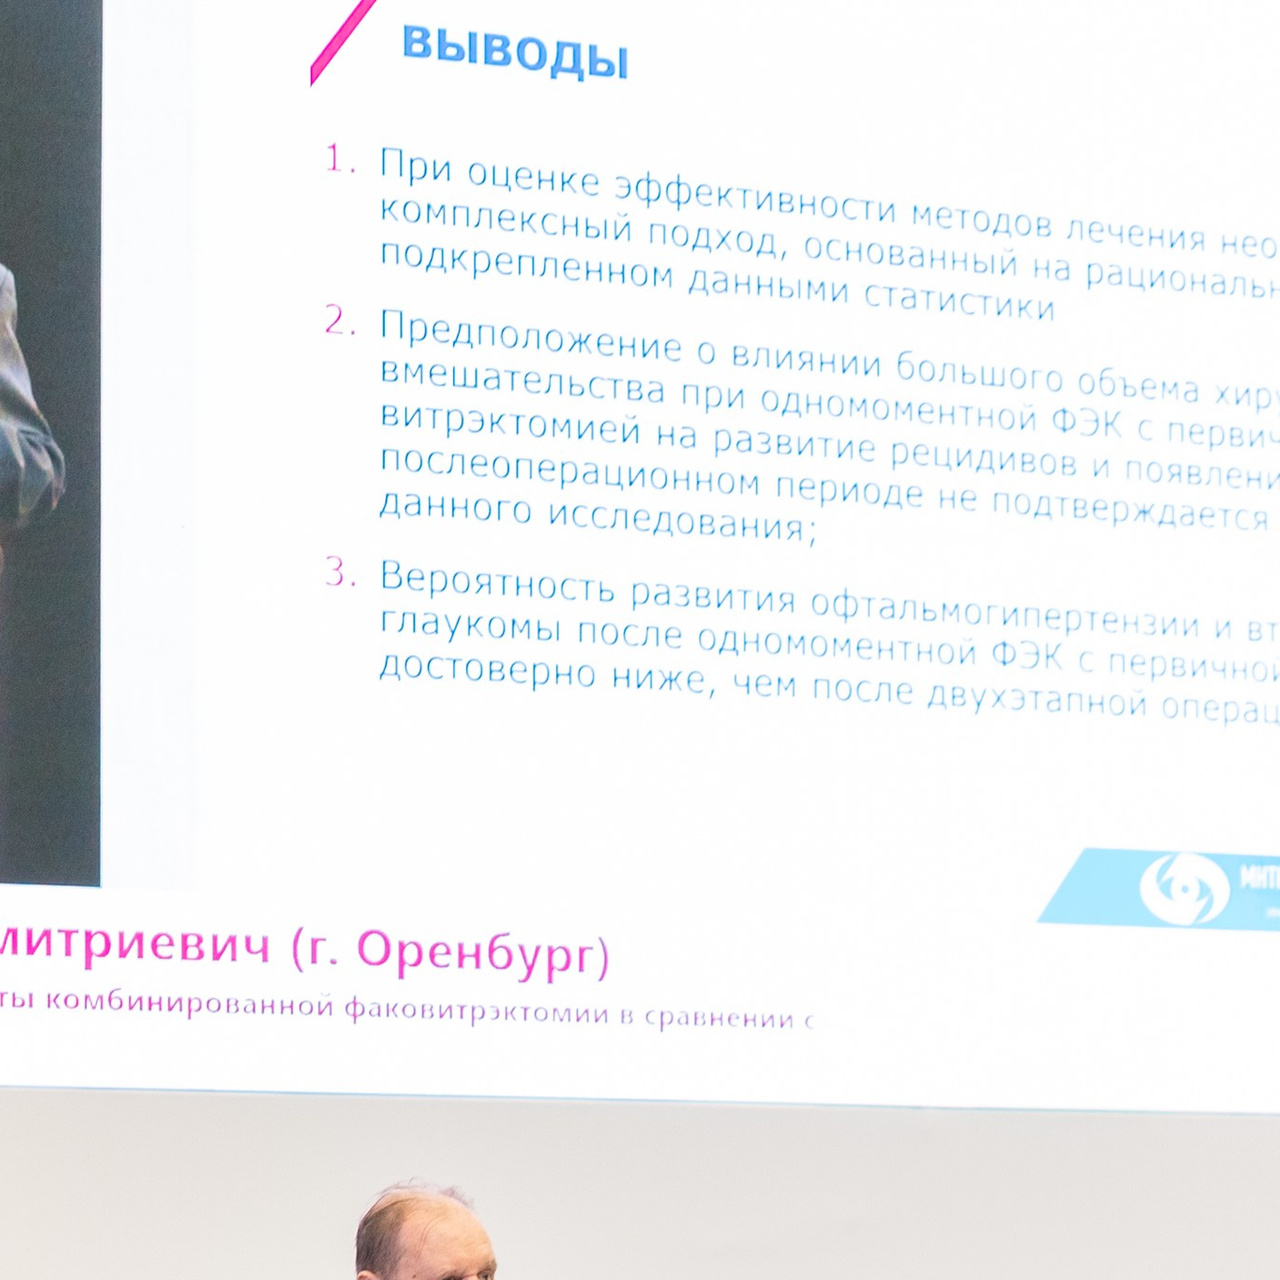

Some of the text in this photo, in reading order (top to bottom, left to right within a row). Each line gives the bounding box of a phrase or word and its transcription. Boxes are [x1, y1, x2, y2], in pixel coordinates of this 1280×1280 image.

[327, 142, 356, 174] 1.
[381, 146, 452, 189] При
[467, 161, 600, 198] оценке
[614, 169, 896, 224] эффективности
[912, 203, 1053, 239] методов
[1066, 219, 1205, 252] лечения
[380, 197, 632, 243] комплексный
[649, 222, 787, 262] подход,
[804, 236, 1017, 277] основанный
[1033, 258, 1071, 282] на
[380, 241, 1055, 322] подкрепленном данными статистики
[325, 303, 356, 336] 2.
[381, 307, 682, 363] Предположение
[697, 341, 716, 366] о
[732, 344, 881, 378] влиянии
[896, 349, 1063, 393] большого
[1077, 366, 1199, 404] объема
[380, 359, 665, 404] вмешательства
[682, 382, 745, 415] при
[760, 389, 1037, 431] одномоментной
[1051, 406, 1122, 438] ФЭК
[1137, 419, 1153, 442] с
[381, 403, 640, 445] витрэктомией
[656, 424, 697, 450] на
[714, 428, 876, 463] развитие
[891, 441, 1077, 477] рецидивов
[1092, 458, 1110, 478] и
[378, 491, 816, 549] данного исследования;
[381, 447, 760, 497] послеоперационном
[776, 475, 924, 511] периоде
[939, 488, 978, 512] не
[993, 491, 1268, 531] подтверждается
[325, 555, 356, 587] 3.
[381, 558, 616, 604] Вероятность
[631, 581, 795, 614] развития
[810, 586, 1199, 638] офтальмогипертензии
[1215, 619, 1231, 639] и
[381, 609, 561, 645] глаукомы
[578, 621, 683, 650] после
[697, 628, 976, 666] одномоментной
[991, 639, 1062, 670] ФЭК
[1078, 651, 1093, 673] с
[378, 653, 596, 693] достоверно
[612, 666, 716, 700] ниже,
[733, 673, 796, 699] чем
[813, 677, 914, 706] после
[926, 684, 1147, 717] двухэтапной
[292, 926, 338, 974] (г.
[357, 928, 609, 985] Оренбург)
[46, 987, 333, 1021] комбинированной
[344, 994, 608, 1028] факовитрэктомии
[620, 1008, 634, 1025] в
[645, 1009, 793, 1033] сравнении
[804, 1015, 813, 1029] с
